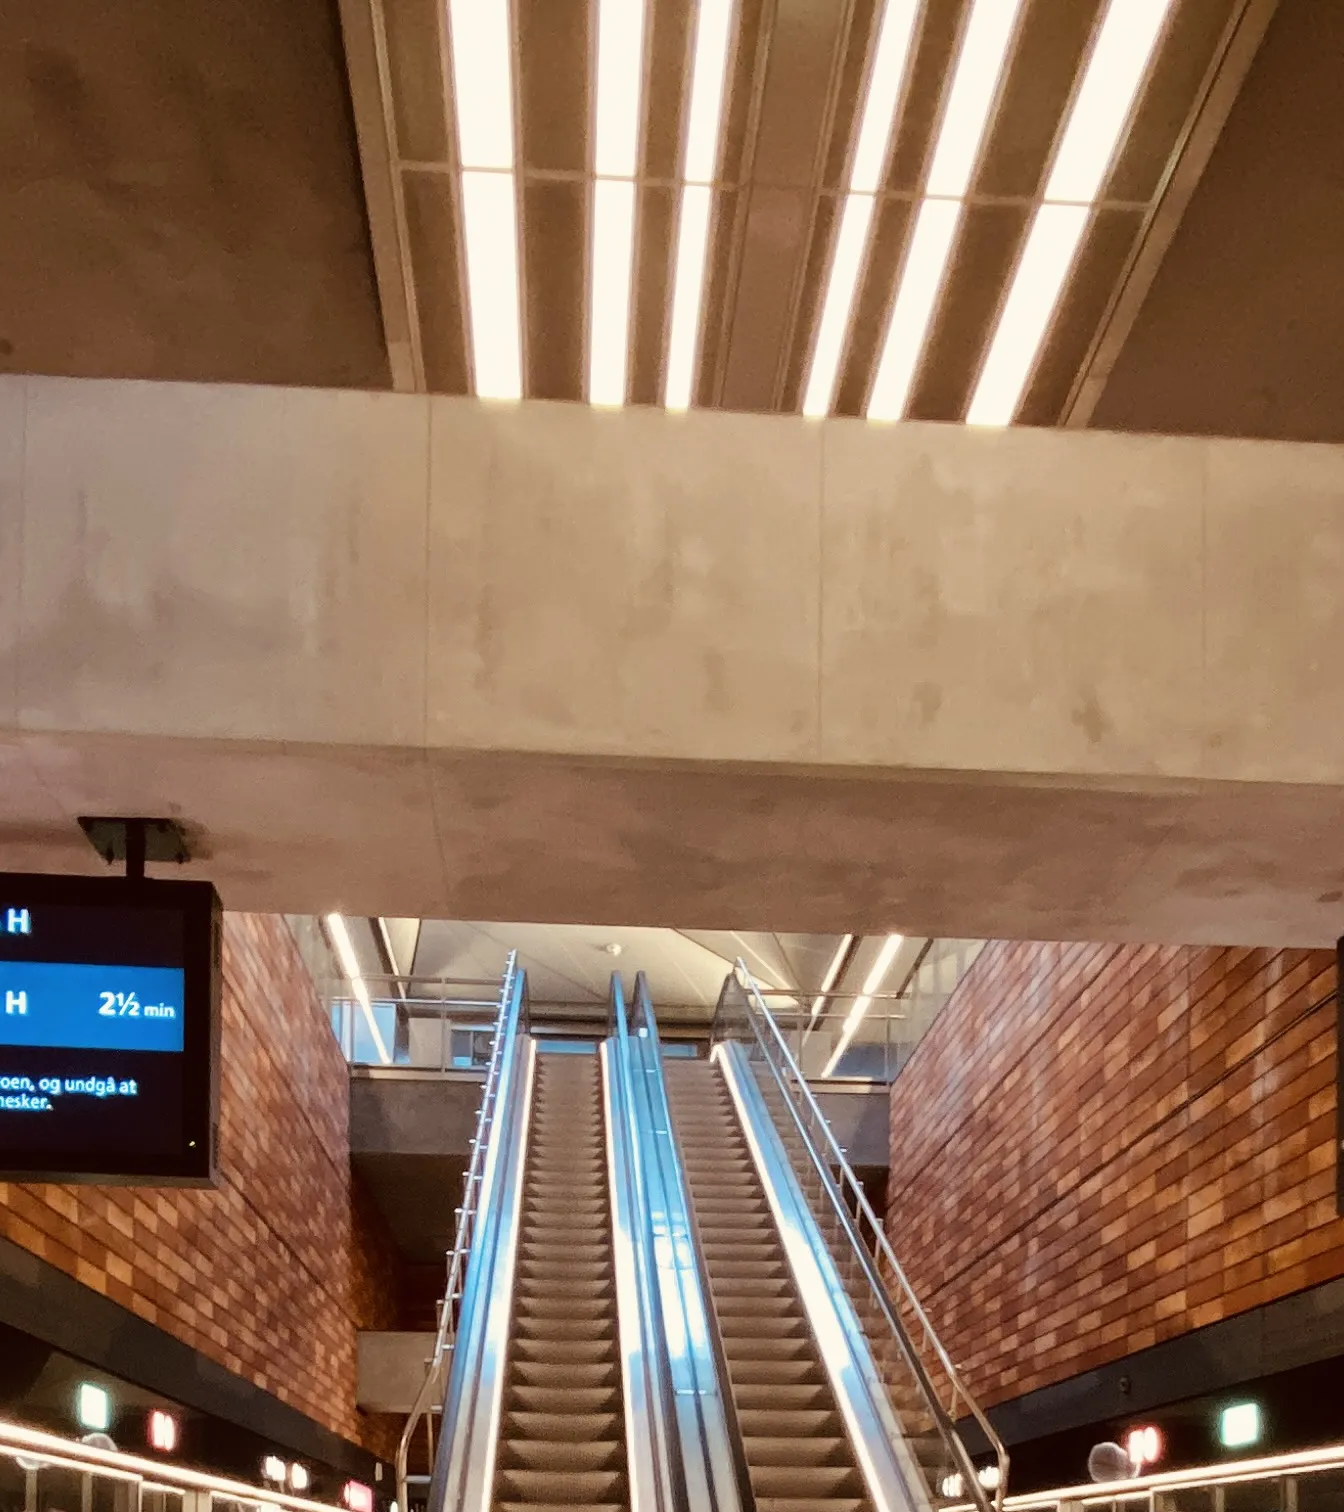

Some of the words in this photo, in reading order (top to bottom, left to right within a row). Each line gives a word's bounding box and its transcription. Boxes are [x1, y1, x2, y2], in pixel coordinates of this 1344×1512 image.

[8, 908, 31, 933] H
[6, 990, 27, 1014] H
[144, 1002, 175, 1017] min
[39, 1079, 61, 1095] og
[65, 1077, 115, 1097] undgå
[119, 1079, 137, 1094] at
